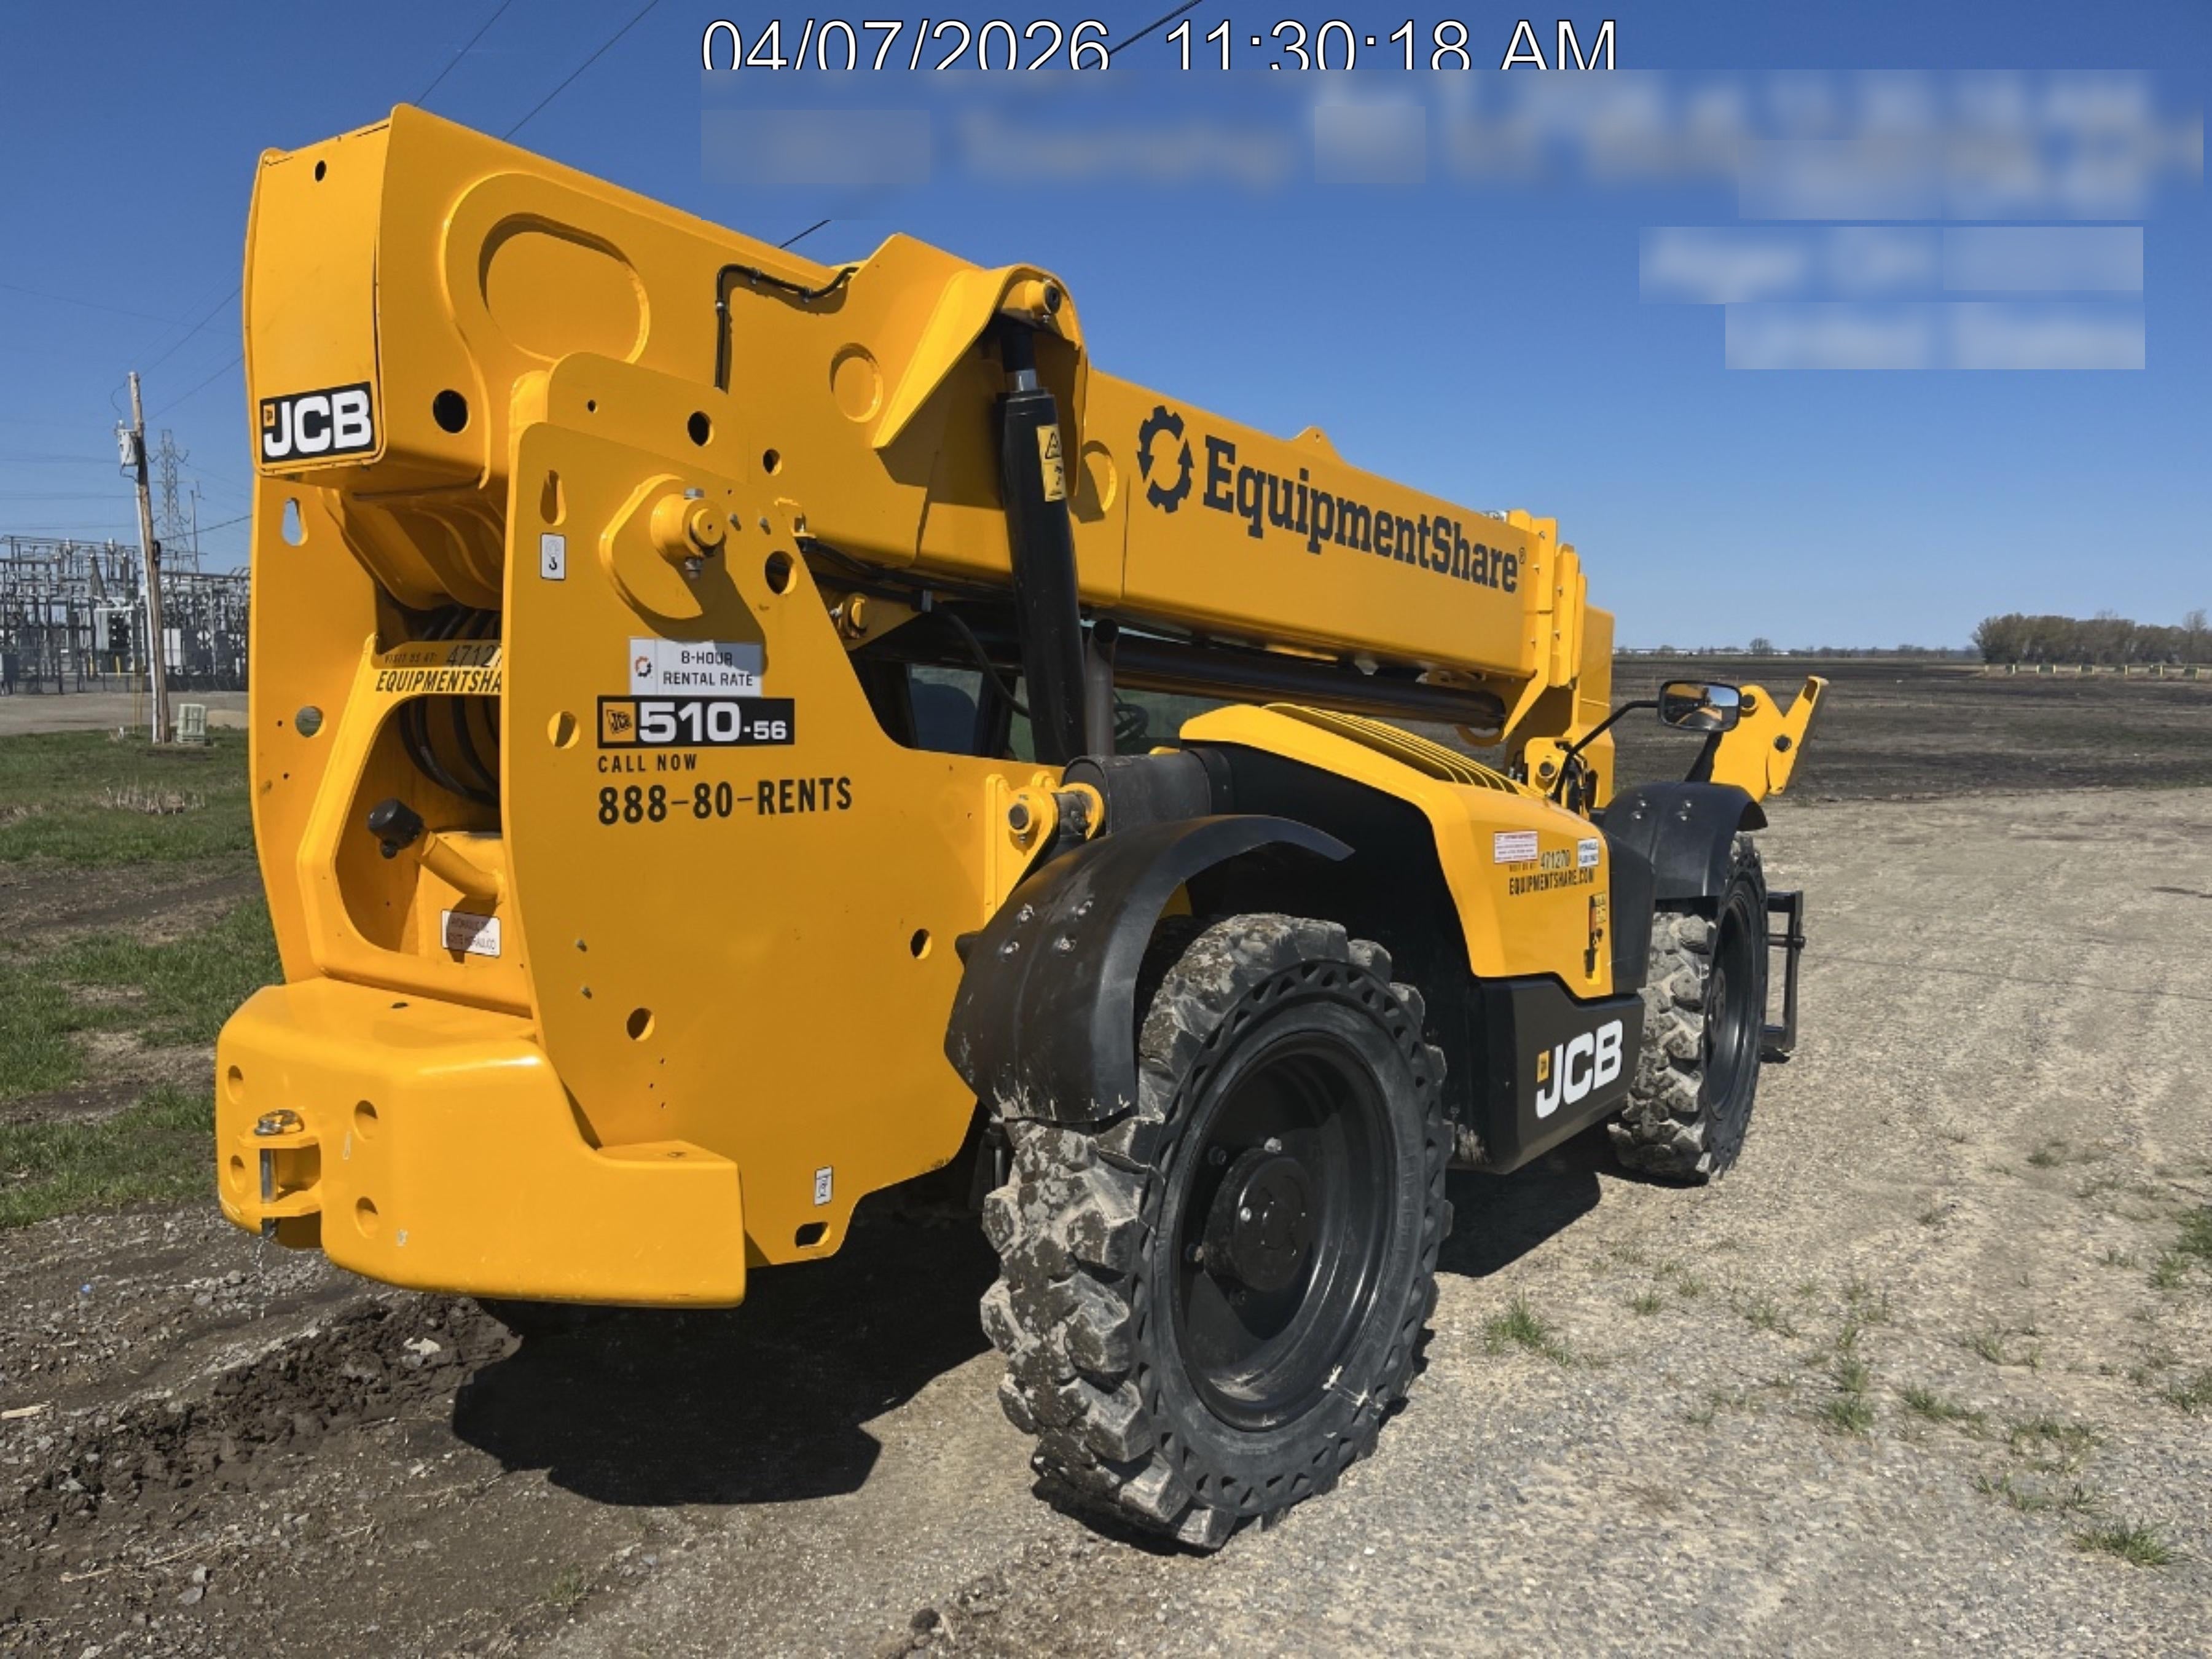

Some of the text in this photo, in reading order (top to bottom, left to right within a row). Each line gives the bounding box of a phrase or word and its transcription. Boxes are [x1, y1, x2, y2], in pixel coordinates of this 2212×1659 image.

[263, 390, 372, 458] JCB
[663, 670, 753, 686] RENTAL RATE
[598, 753, 697, 773] CALL NOW
[598, 776, 853, 825] 888-80-RENTS
[1509, 867, 1594, 895] EQUIPMENTSHARE.COM
[1536, 1019, 1623, 1120] JCB
